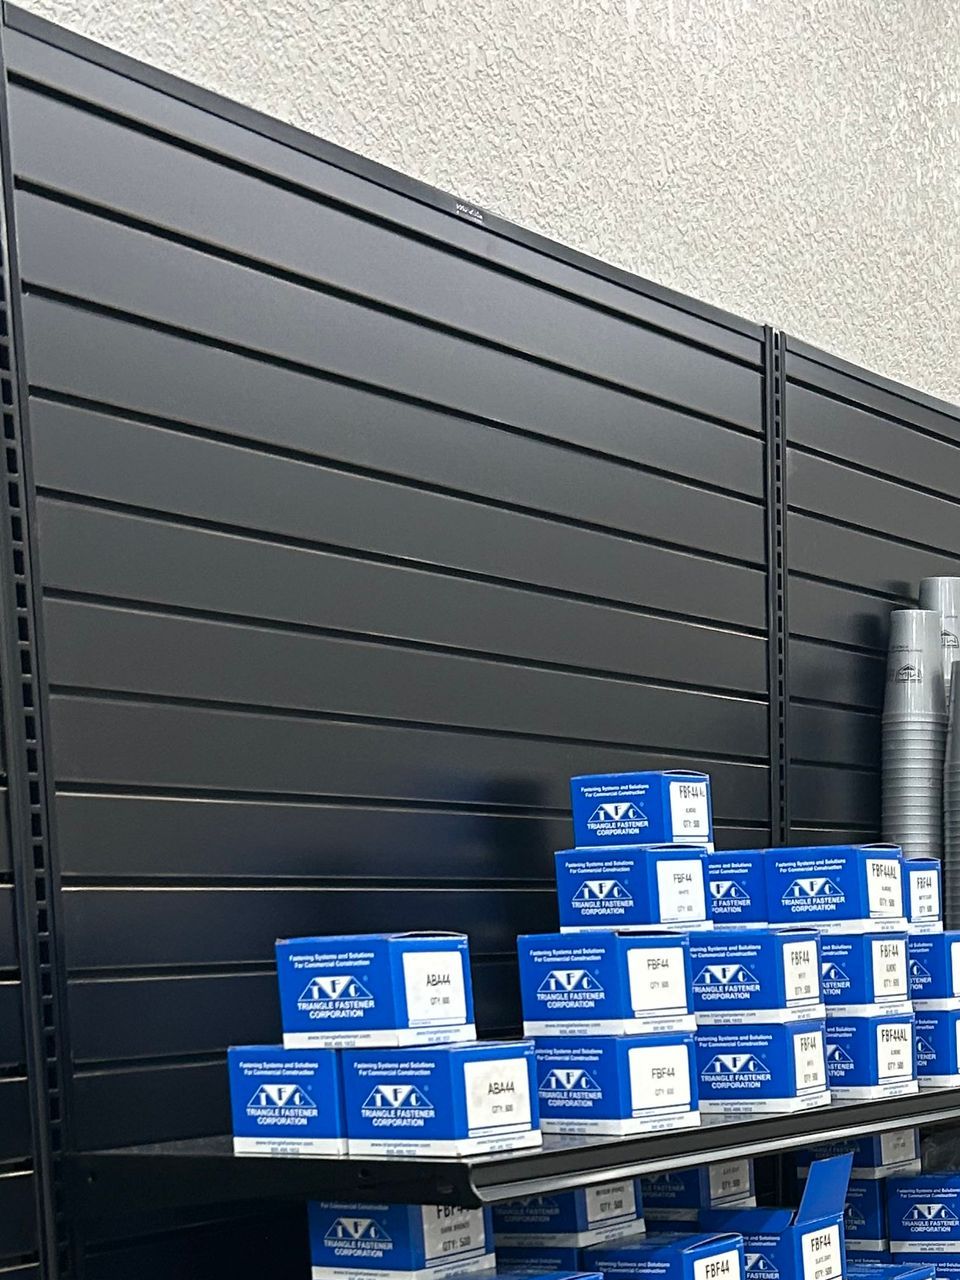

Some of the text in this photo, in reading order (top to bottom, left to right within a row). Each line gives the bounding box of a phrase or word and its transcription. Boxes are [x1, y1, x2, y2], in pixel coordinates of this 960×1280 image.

[782, 898, 810, 906] TRIANGLE
[581, 907, 625, 915] CORPORATION
[791, 904, 836, 912] CORPORATION
[426, 975, 450, 987] ABA44
[536, 992, 605, 1001] TRIANGLE FASTENER
[297, 1000, 375, 1010] TRIANGLE FASTENER
[309, 1010, 363, 1019] CORPORATION
[701, 1074, 734, 1082] TRIANGLE
[488, 1082, 515, 1095] ABA44
[712, 1080, 761, 1089] CORPORATION
[247, 1109, 318, 1117] TRIANGLE FASTENER
[361, 1109, 435, 1118] TRIANGLE FASTENER
[257, 1116, 307, 1126] CORPORATION
[372, 1118, 424, 1127] CORPORATION
[705, 1259, 730, 1279] FBF44
